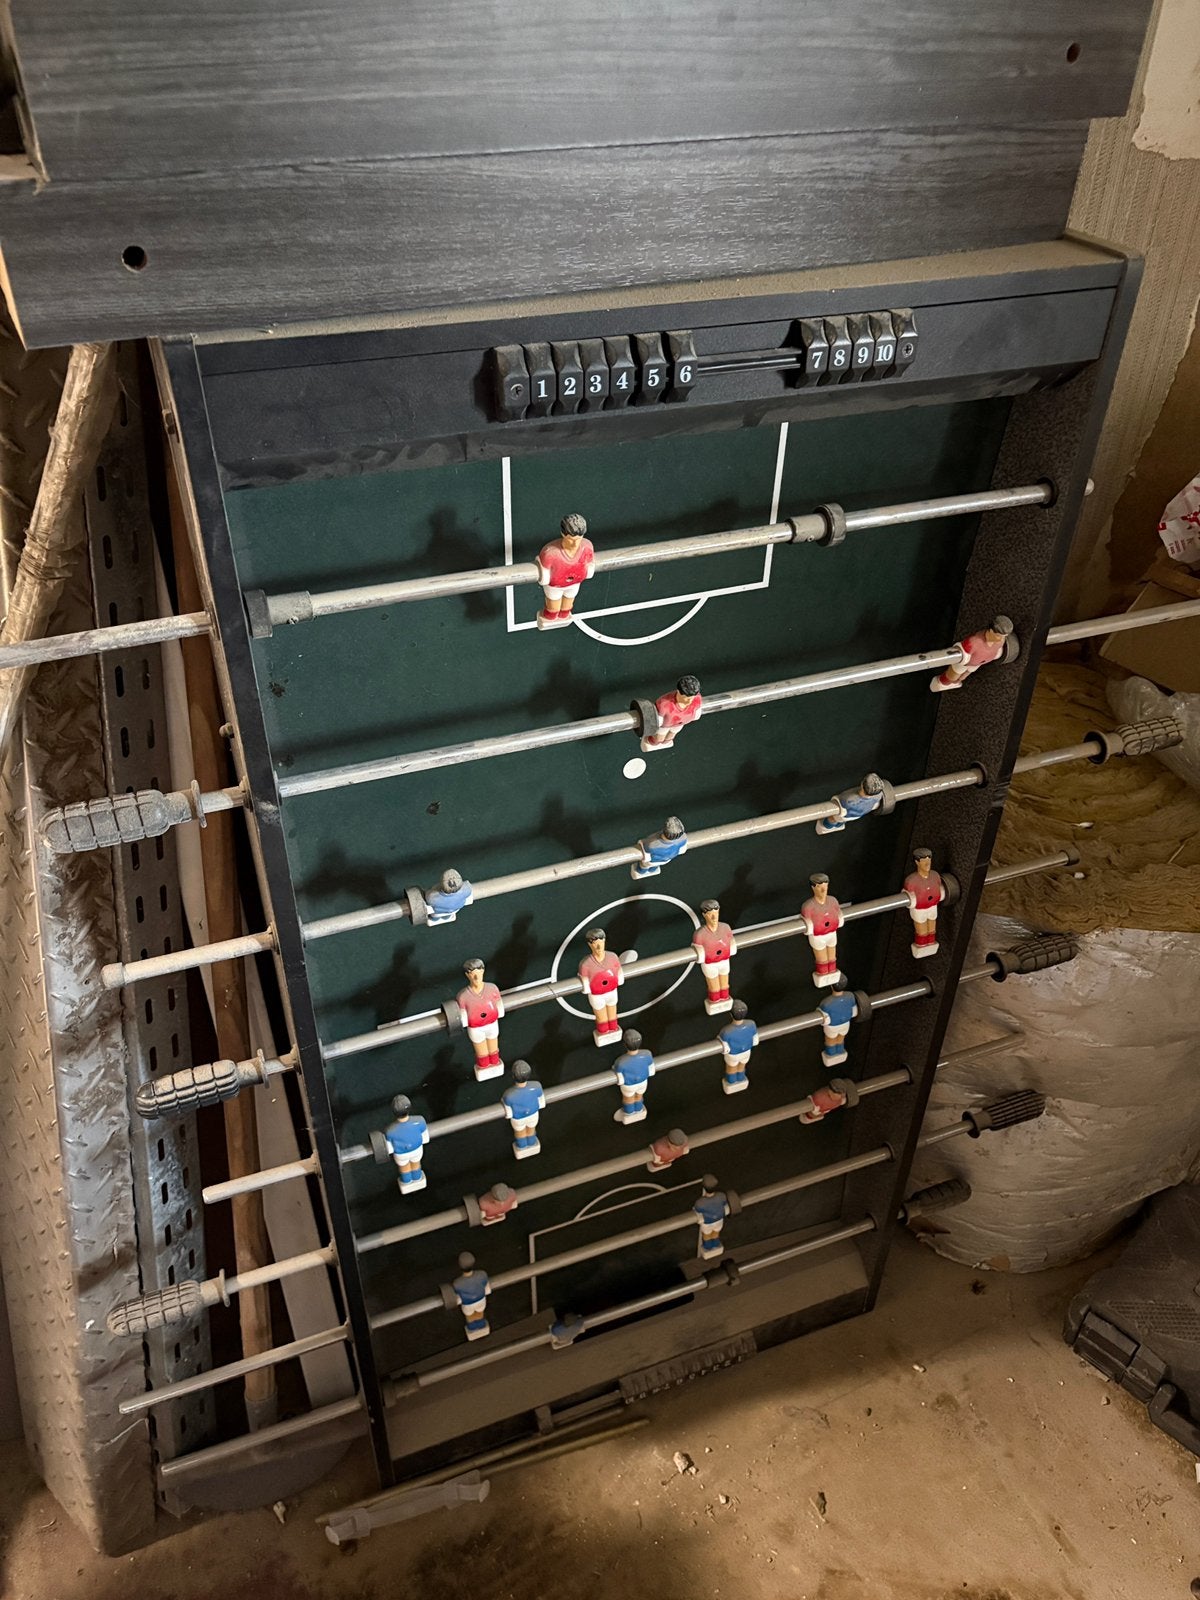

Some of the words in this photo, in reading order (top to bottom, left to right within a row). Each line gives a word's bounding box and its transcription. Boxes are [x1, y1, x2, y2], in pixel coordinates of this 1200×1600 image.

[537, 379, 548, 398] 1
[563, 376, 576, 396] 2
[589, 374, 602, 393] 3
[616, 371, 629, 390] 4
[647, 368, 660, 387] 5
[679, 365, 692, 384] 6
[811, 351, 824, 369] 7
[833, 349, 846, 367] 8
[857, 346, 869, 364] 9
[875, 343, 894, 362] 10
